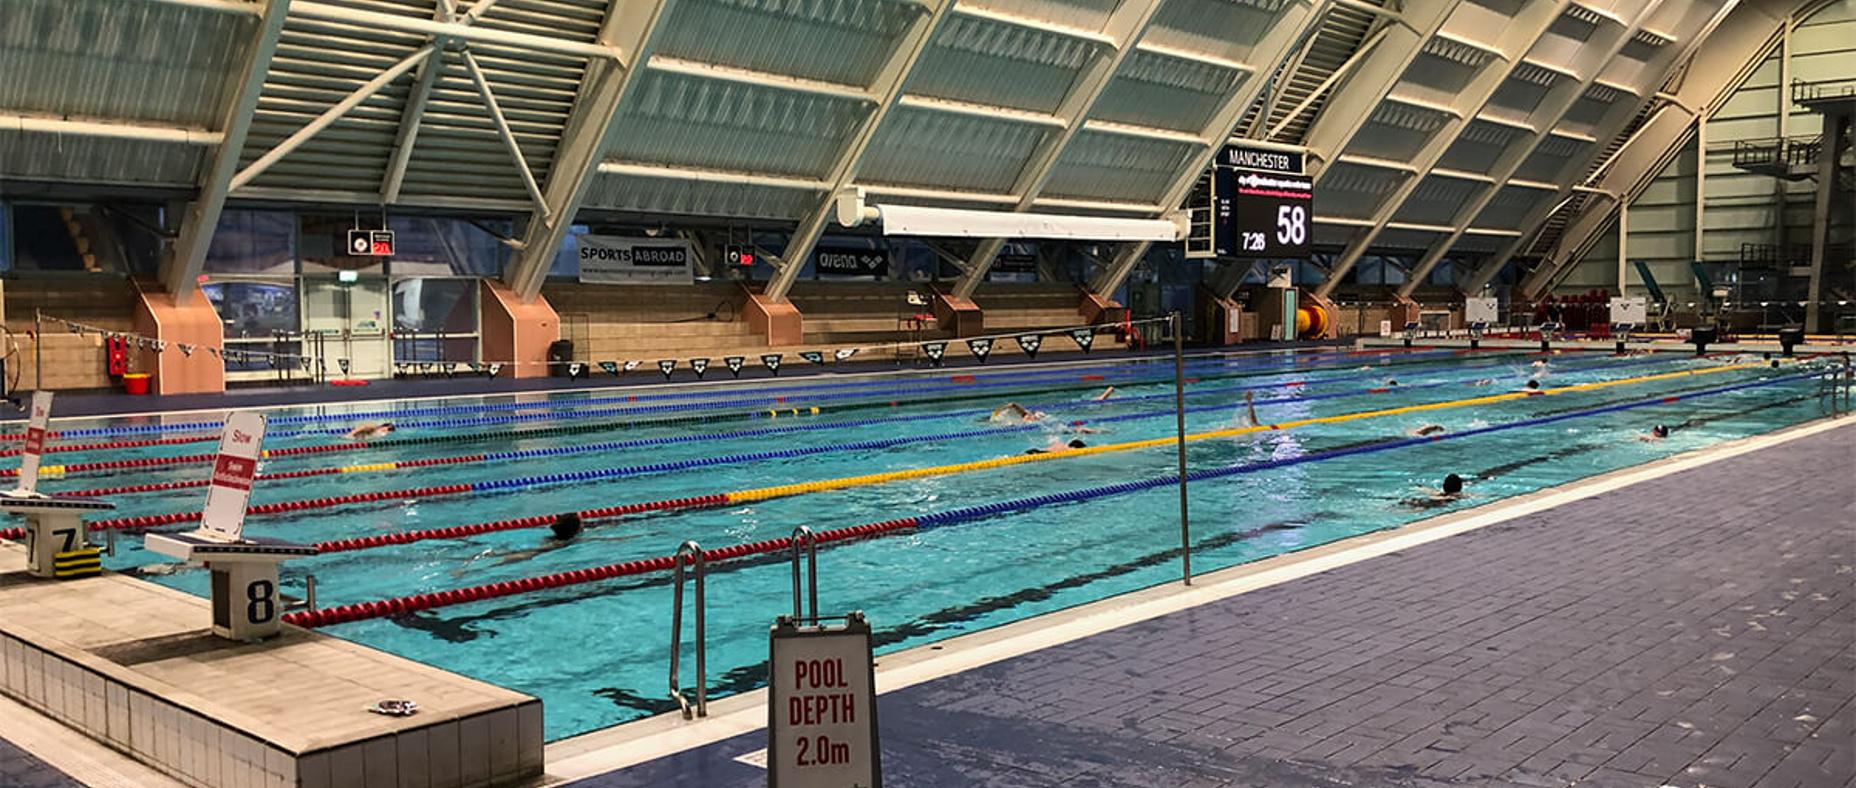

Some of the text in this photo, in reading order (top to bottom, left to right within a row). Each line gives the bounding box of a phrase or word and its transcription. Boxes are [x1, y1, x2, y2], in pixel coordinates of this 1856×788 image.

[1229, 149, 1290, 170] MANCHESTER
[1277, 205, 1306, 245] 58
[580, 247, 685, 264] SPORTS ABROAD
[52, 527, 77, 553] 7
[246, 580, 275, 624] 8
[794, 658, 849, 690] POOL
[789, 693, 855, 726] DEPTH
[796, 735, 850, 767] 2.0m
